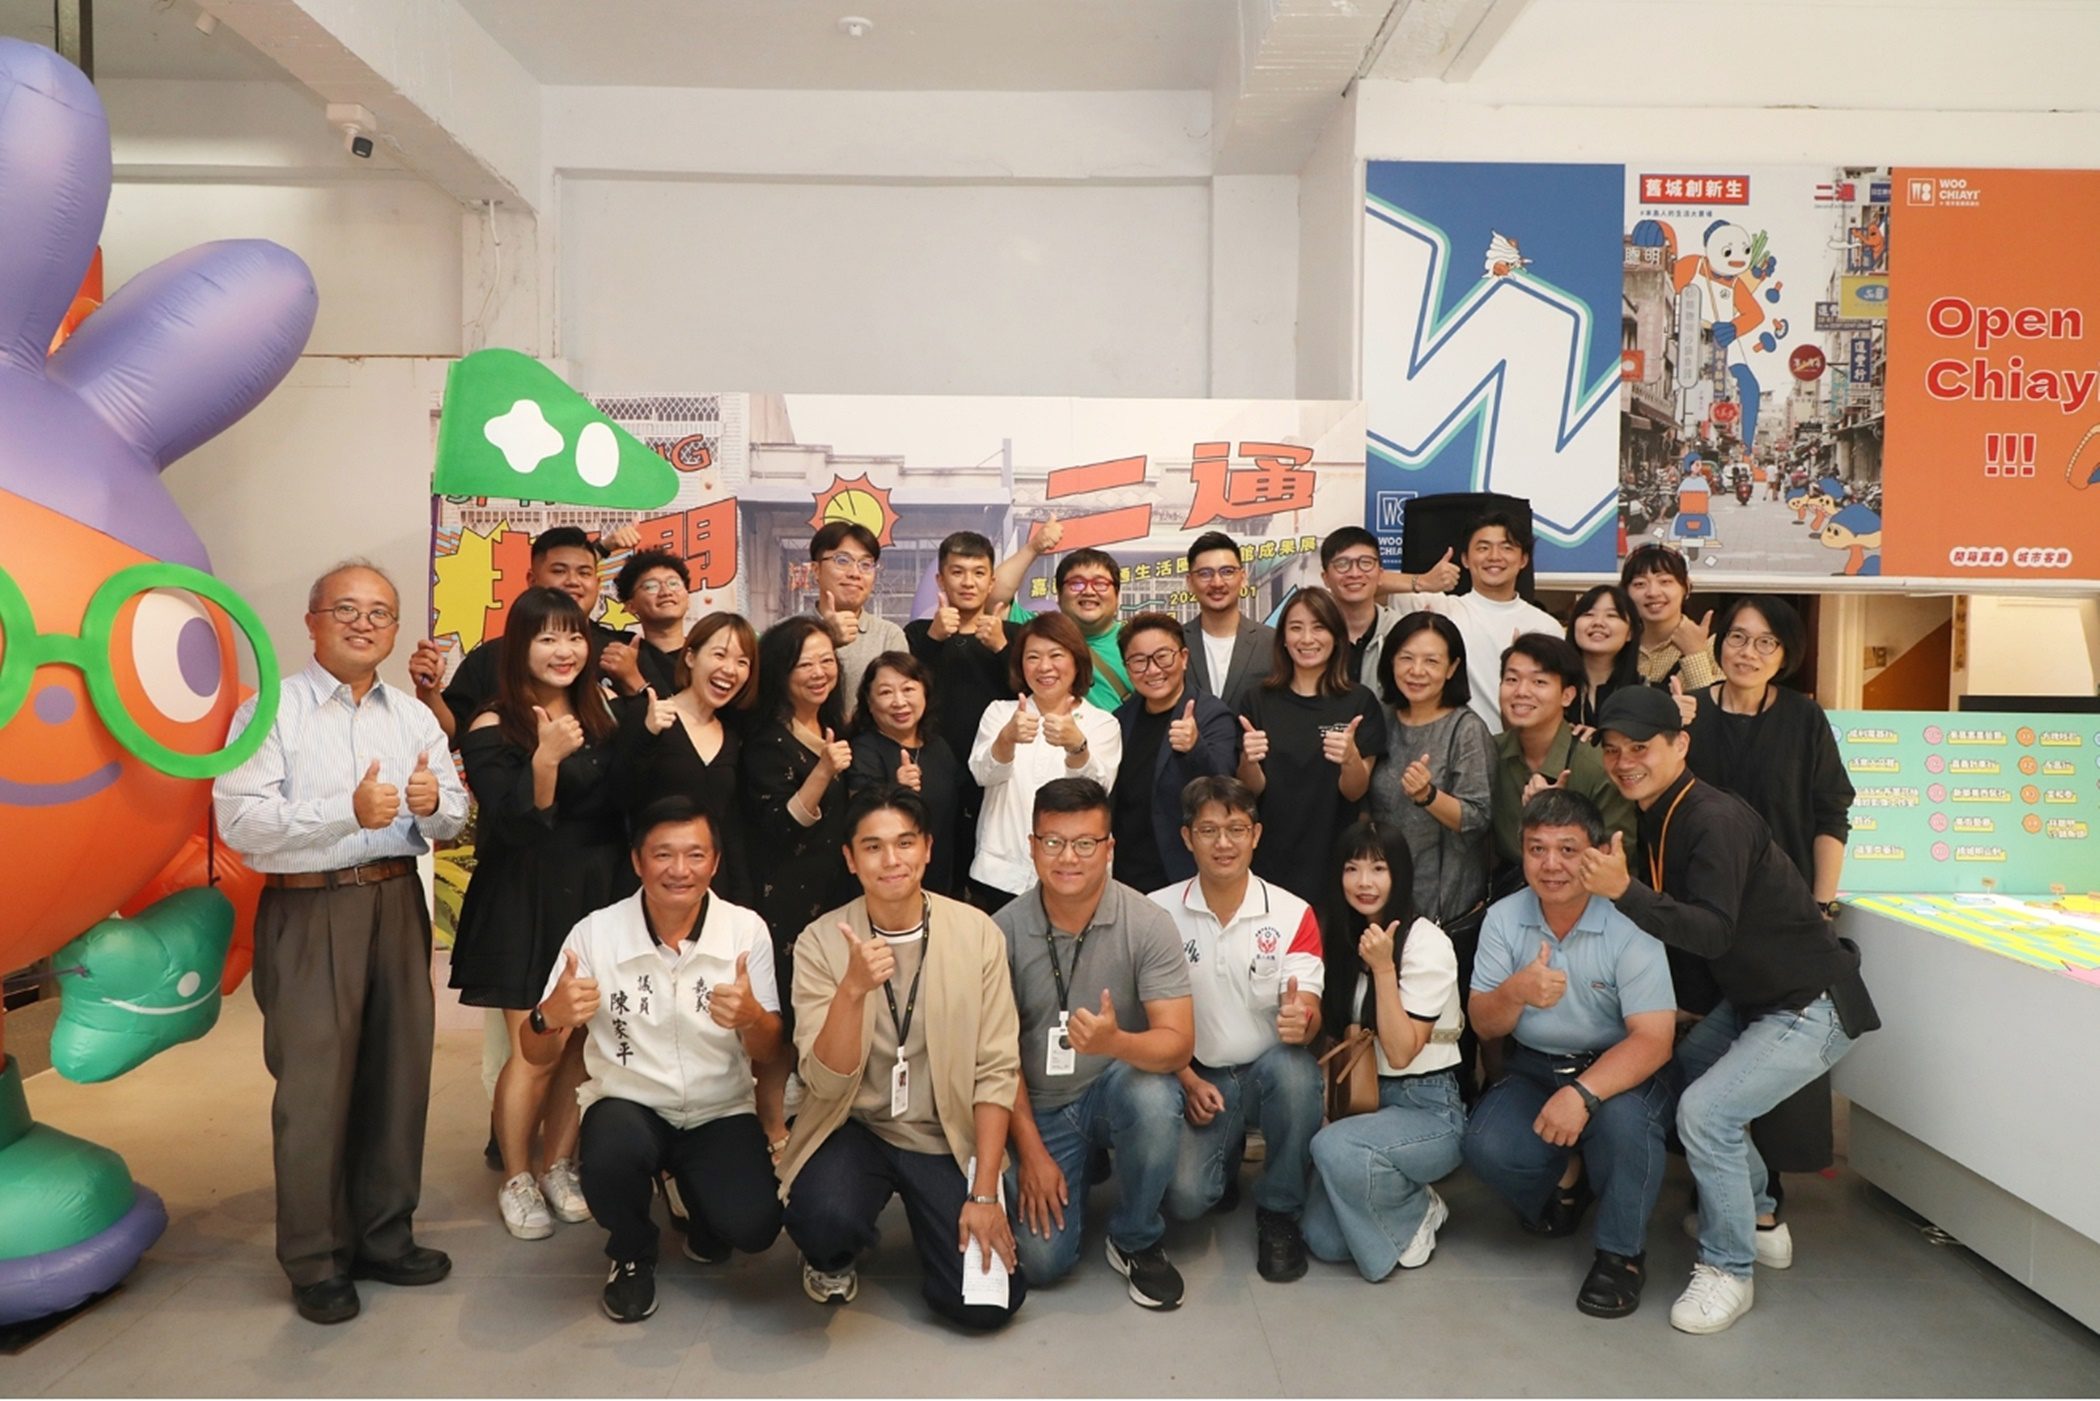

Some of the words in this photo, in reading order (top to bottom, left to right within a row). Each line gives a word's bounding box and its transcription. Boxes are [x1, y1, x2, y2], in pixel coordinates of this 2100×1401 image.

[1645, 178, 1743, 198] 舊城創新生
[1939, 179, 1967, 189] WOO
[1927, 296, 2083, 349] Open
[1925, 355, 2100, 415] Chiay
[1985, 433, 2037, 477] !!!
[1380, 546, 1403, 556] CHIA
[637, 974, 653, 1016] 議員
[610, 990, 634, 1067] 陳家平
